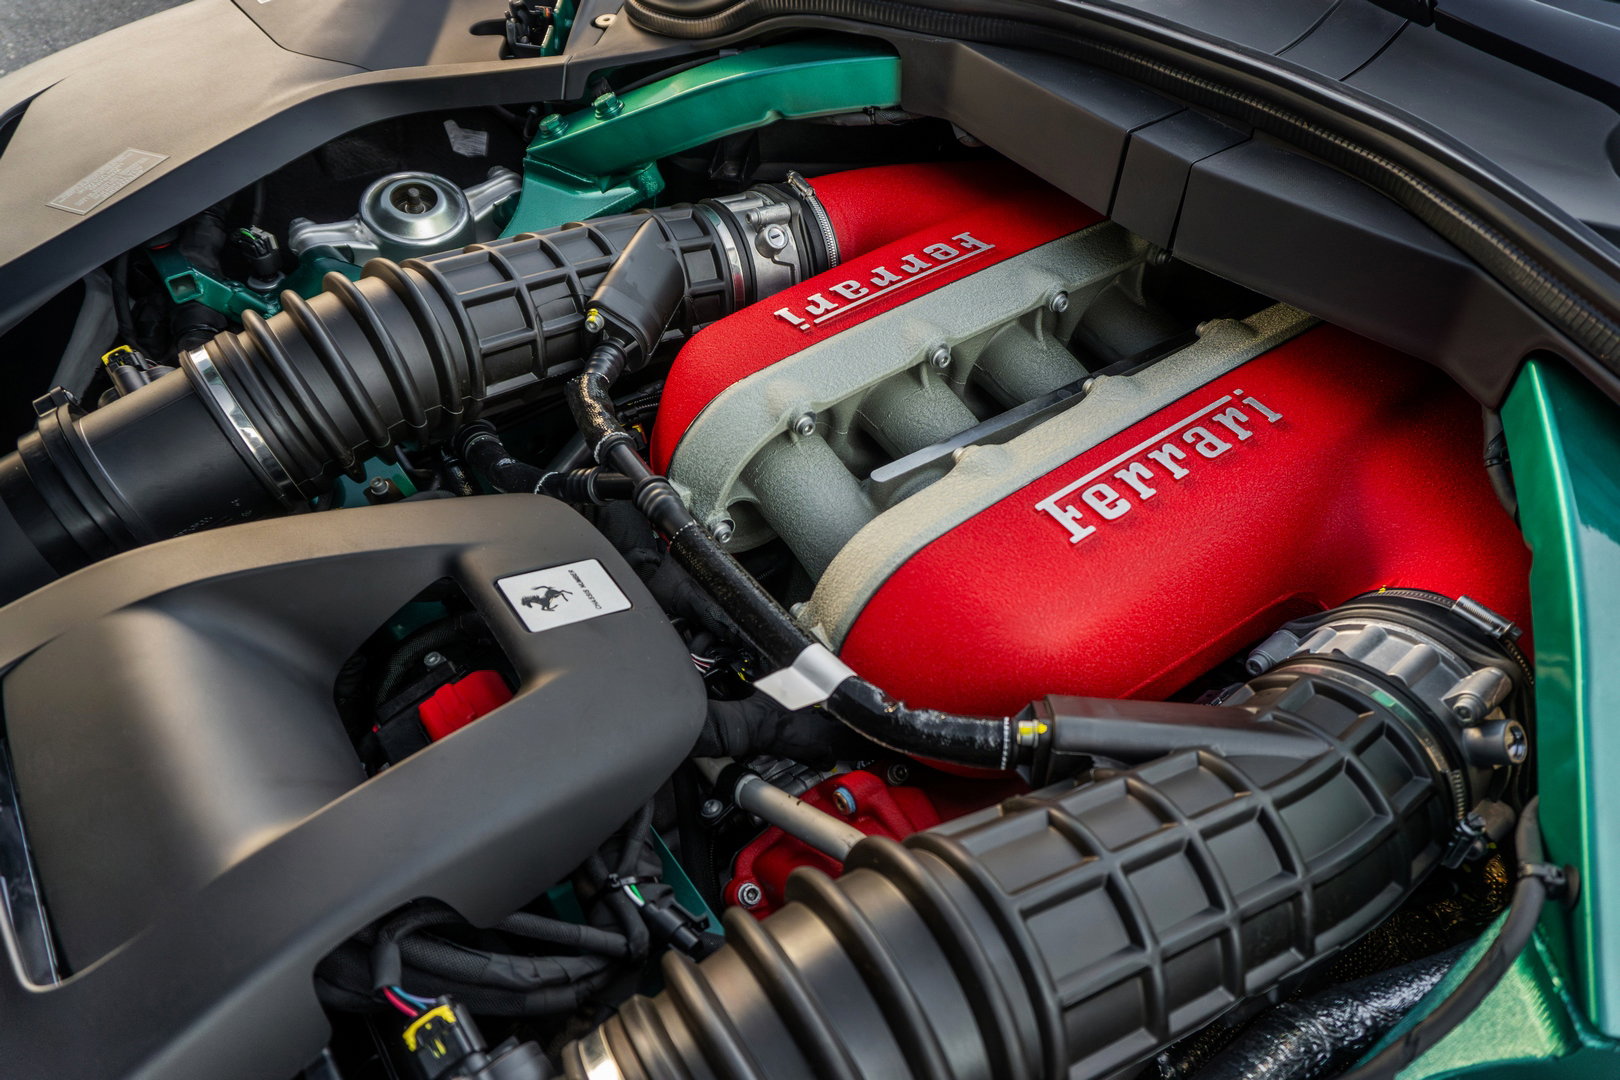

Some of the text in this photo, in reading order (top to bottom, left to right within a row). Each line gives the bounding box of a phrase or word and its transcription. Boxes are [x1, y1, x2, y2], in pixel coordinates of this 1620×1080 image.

[774, 231, 995, 330] Ferrari
[1034, 388, 1283, 544] Ferrari
[568, 570, 602, 609] CHASSIS NUMBER
